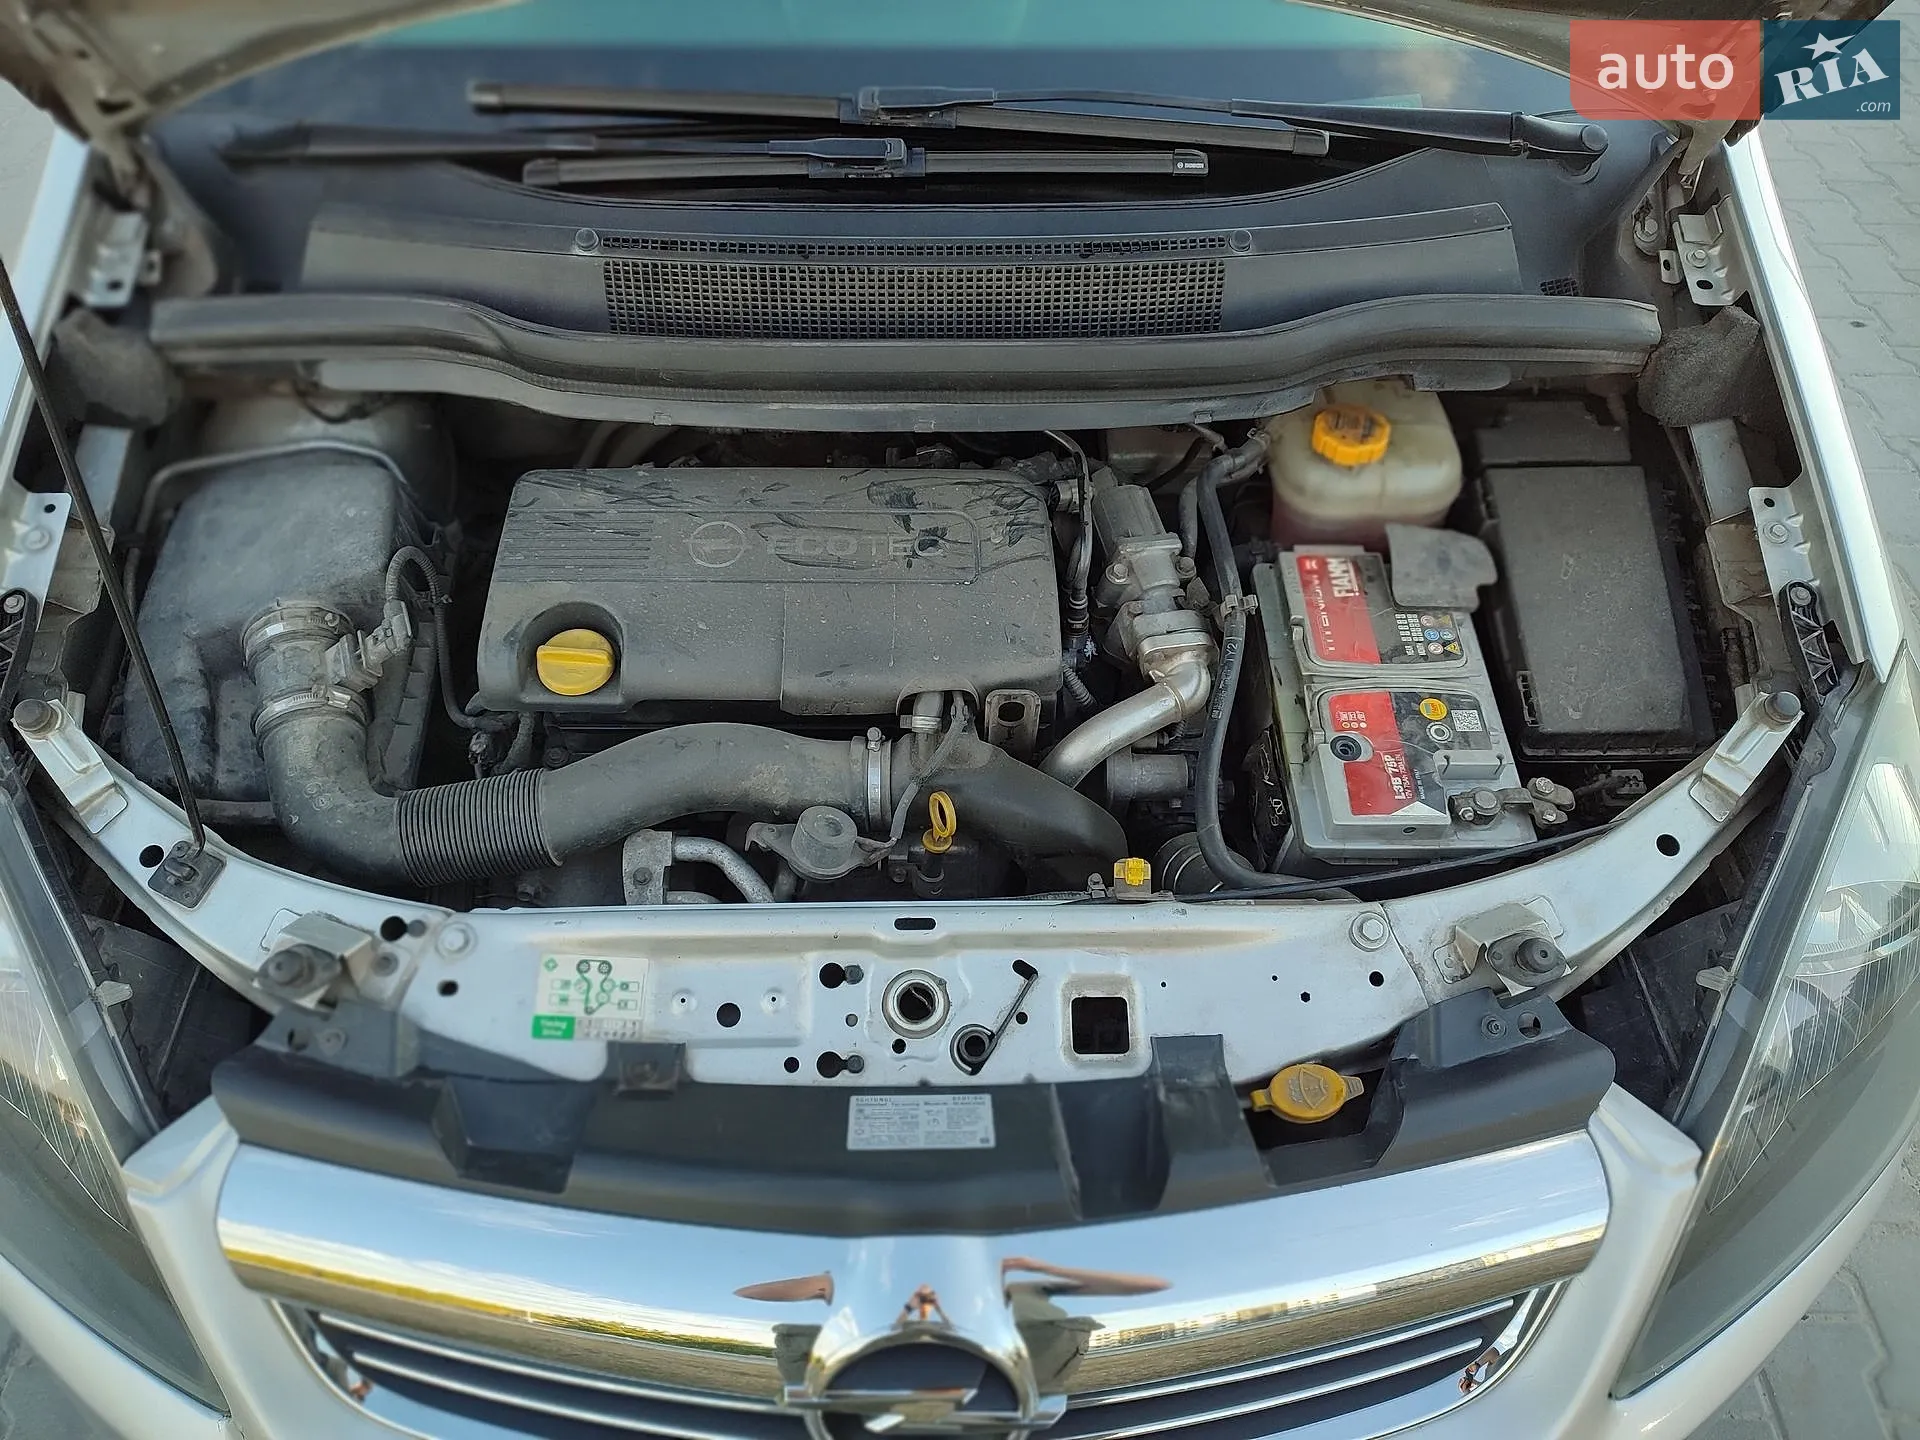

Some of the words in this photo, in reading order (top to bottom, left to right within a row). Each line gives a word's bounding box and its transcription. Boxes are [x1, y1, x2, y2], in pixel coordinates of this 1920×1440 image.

[1325, 557, 1356, 598] FIAMM
[1384, 754, 1400, 774] 75P
[1391, 776, 1406, 801] L3B
[1404, 789, 1413, 799] 12V
